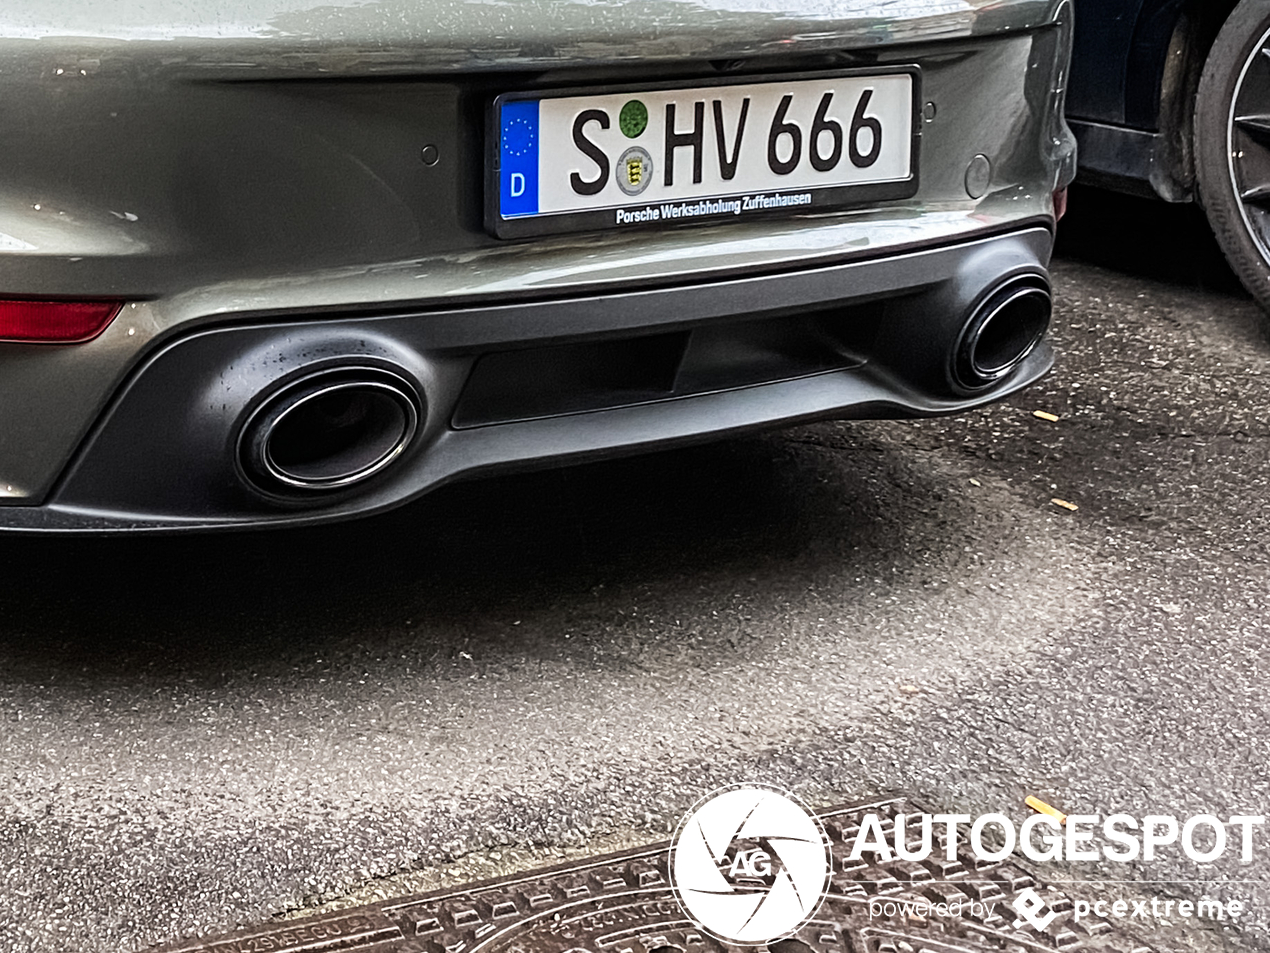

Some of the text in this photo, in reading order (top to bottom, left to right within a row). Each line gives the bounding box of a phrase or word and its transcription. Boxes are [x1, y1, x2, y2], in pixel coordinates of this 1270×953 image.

[569, 108, 611, 196] S
[663, 95, 751, 187] HV
[767, 86, 883, 176] 666
[510, 172, 526, 198] D
[615, 193, 812, 224] Porsche Werksabholung Zuffenhausen
